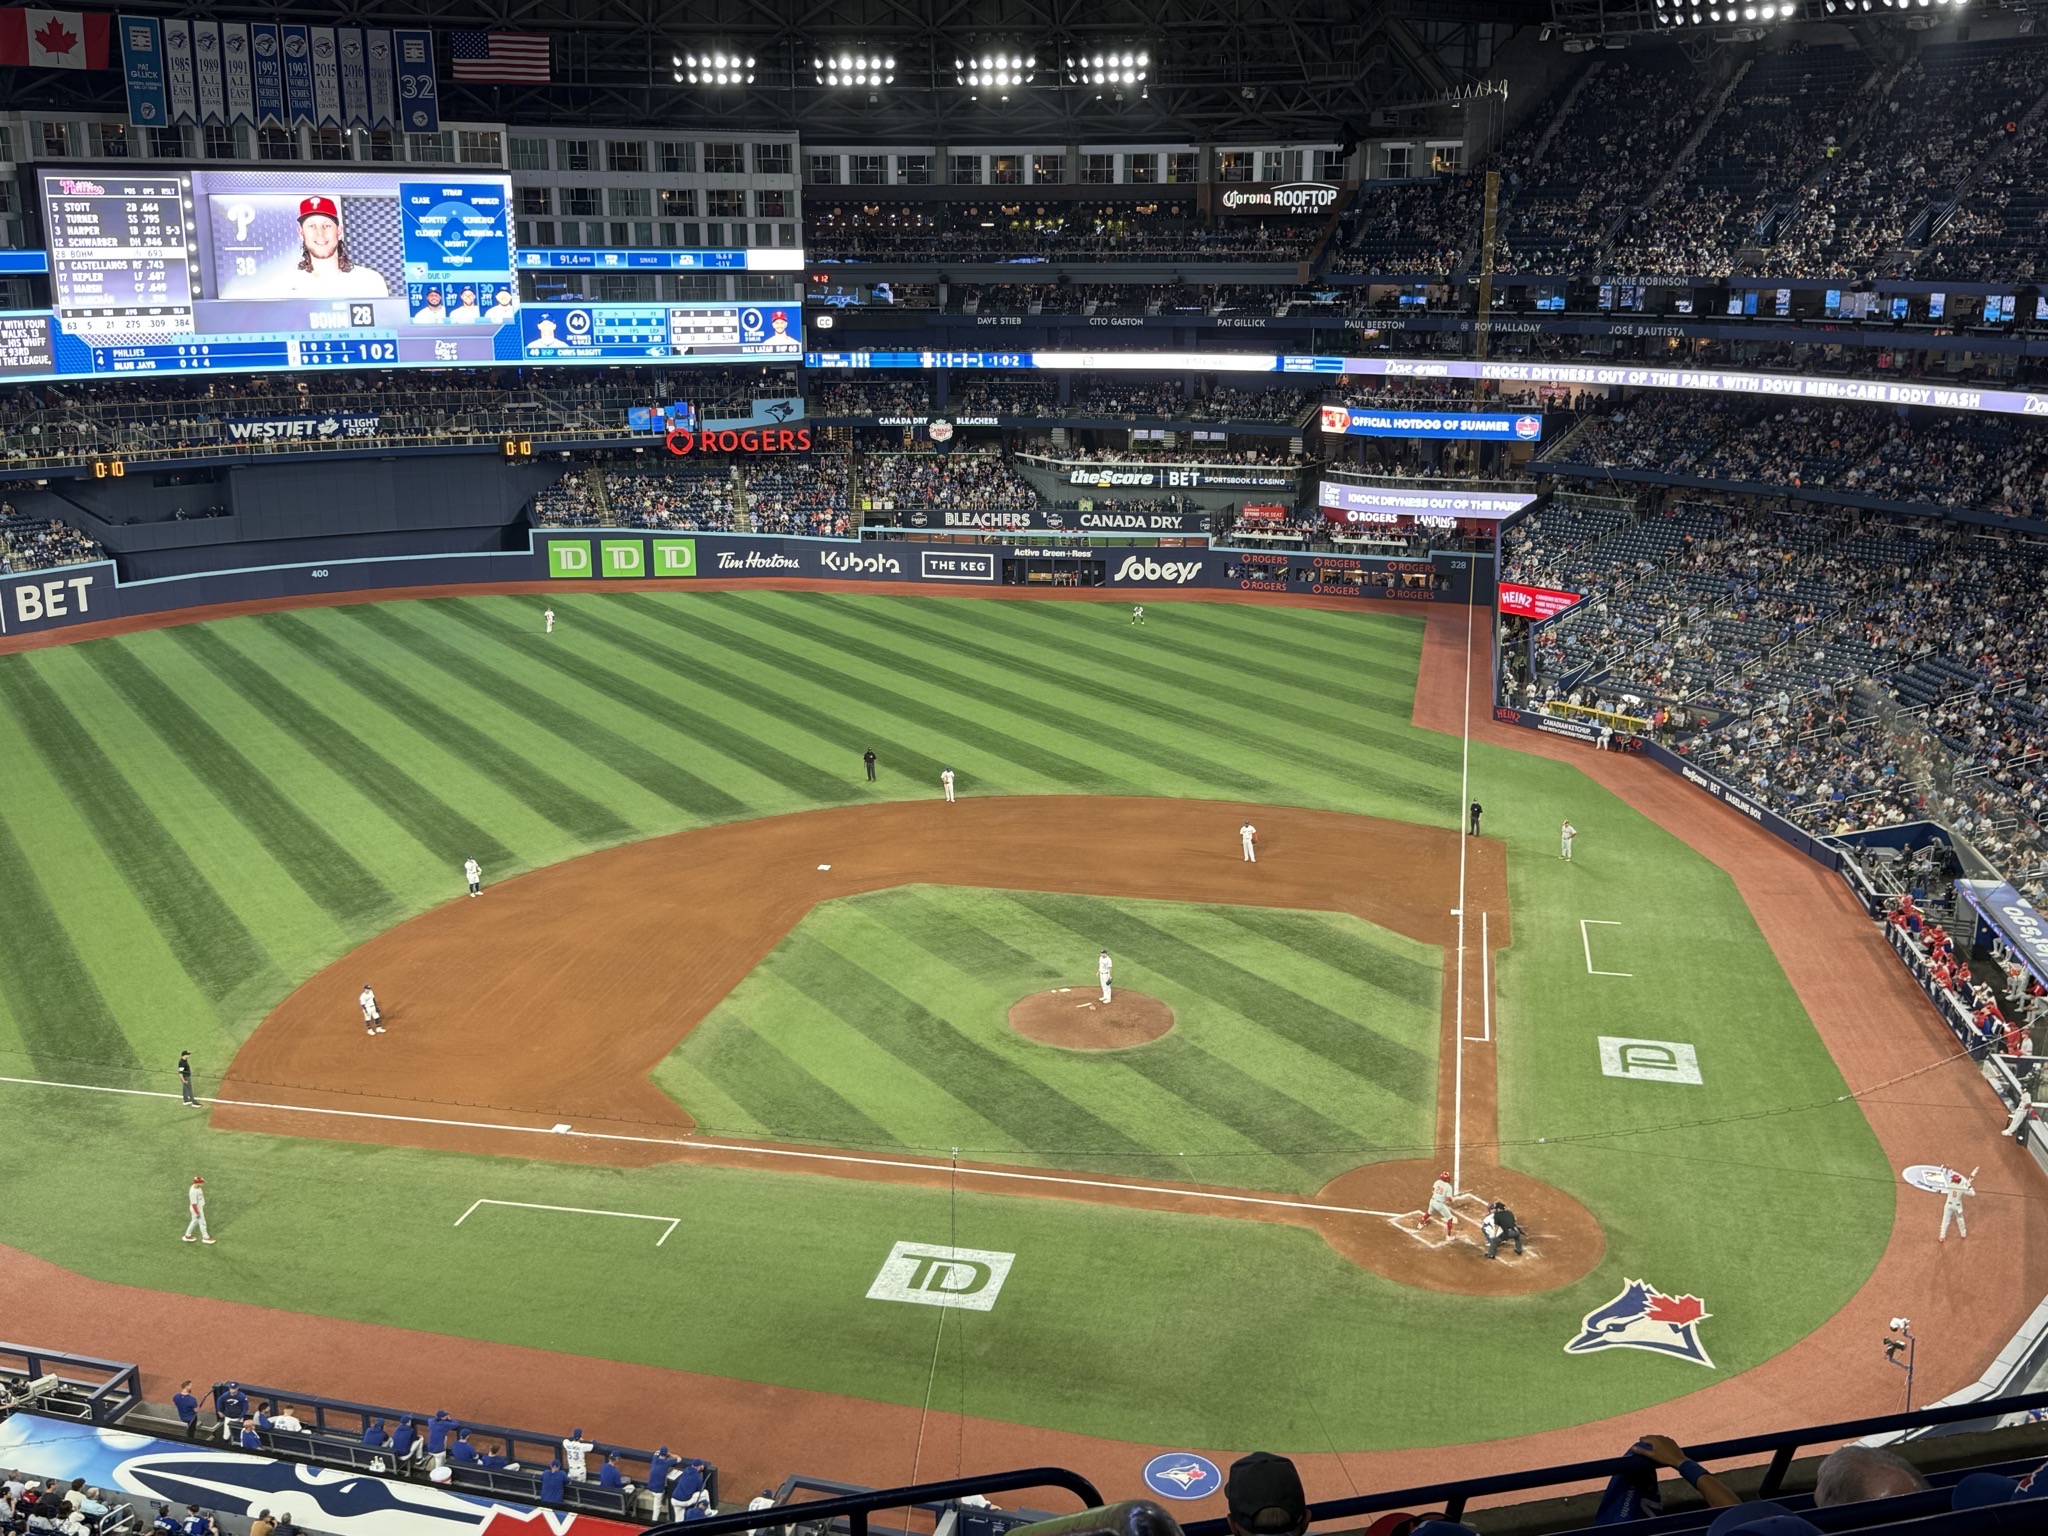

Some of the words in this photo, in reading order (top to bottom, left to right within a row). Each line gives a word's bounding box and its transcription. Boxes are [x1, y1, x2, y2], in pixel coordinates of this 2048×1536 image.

[137, 63, 149, 71] PAT
[170, 57, 191, 71] 1985
[199, 59, 219, 72] 1989
[228, 60, 248, 74] 1991
[257, 61, 278, 76] 1992
[288, 62, 308, 77] 1993
[316, 63, 336, 78] 2015
[344, 64, 364, 78] 2016
[230, 76, 250, 87] A.L.
[258, 77, 279, 87] WORLD
[289, 78, 309, 88] WORLD
[400, 74, 435, 99] 32
[173, 86, 192, 96] EAST
[201, 87, 220, 98] EAST
[230, 88, 250, 99] EAST
[259, 88, 280, 98] SERIES
[290, 89, 310, 98] SERIES
[1223, 190, 1271, 209] Corona
[1274, 190, 1337, 206] ROOFTOP
[64, 203, 90, 212] STOTT
[126, 203, 138, 212] 2B
[140, 203, 159, 212] .664
[1291, 206, 1319, 214] PATIO
[65, 214, 99, 224] TURNER
[127, 214, 138, 223] SS
[141, 214, 160, 223] .795
[67, 226, 100, 235] HARPER
[129, 226, 139, 235] 1B
[165, 225, 180, 235] 5-3
[54, 238, 64, 247] 12
[68, 238, 119, 247] SCHWARBER
[129, 238, 141, 247] DH
[55, 250, 66, 258] 28
[70, 250, 94, 258] BOHM
[560, 254, 578, 264] 91.4
[71, 261, 128, 270] CASTELLANOS
[132, 261, 143, 269] RF
[146, 261, 165, 269] .743
[235, 256, 257, 276] 3B
[59, 273, 67, 282] 17
[72, 273, 103, 282] KEPLER
[1606, 276, 1637, 285] JACKIE
[1639, 276, 1689, 286] ROBINSON
[60, 285, 70, 293] 16
[73, 284, 103, 293] MARSH
[410, 284, 423, 294] 27
[481, 284, 494, 293] 30
[309, 310, 350, 330] BOHM
[352, 305, 373, 326] 28
[571, 316, 585, 326] 44
[977, 317, 997, 325] DAVE
[1000, 317, 1021, 325] STIEB
[4, 320, 24, 330] WITH
[25, 319, 46, 329] FOUR
[67, 321, 78, 330] 63
[106, 321, 115, 329] 21
[1089, 317, 1108, 326] CITO
[1111, 318, 1143, 326] GASTON
[1217, 319, 1232, 327] PAT
[1234, 319, 1265, 327] GILLICK
[1344, 320, 1364, 329] PAUL
[1367, 321, 1405, 329] BEESTON
[1474, 323, 1493, 331] ROY
[1495, 323, 1541, 333] HALLADAY
[1608, 324, 1633, 335] JOSÉ
[1637, 326, 1685, 337] BAUTISTA
[23, 338, 46, 348] WHIFF
[9, 347, 29, 358] 93RD
[113, 348, 145, 357] PHILLIES
[20, 355, 52, 366] LEAGUE,
[114, 361, 134, 370] BLUE
[137, 361, 156, 369] JAYS
[1385, 360, 1412, 374] Dove
[1481, 365, 1528, 379] KNOCK
[1531, 366, 1595, 382] DRYNESS
[1597, 369, 1625, 383] OUT
[1628, 371, 1647, 384] OF
[1651, 372, 1677, 386] THE
[1681, 374, 1720, 388] PARK
[1722, 376, 1759, 391] WITH
[1762, 378, 1802, 394] DOVE
[1805, 381, 1887, 400] MEN+CARE
[1889, 387, 1931, 404] BODY
[1934, 390, 1980, 408] WASH
[879, 417, 911, 425] CANADA
[912, 417, 928, 425] DRY
[956, 417, 998, 425] BLEACHERS
[1352, 416, 1392, 428] OFFICIAL
[1393, 419, 1441, 430] HOTDOG
[1443, 420, 1458, 431] OF
[1460, 420, 1509, 432] SUMMER
[229, 420, 317, 438] WESTJET
[342, 417, 380, 428] FLIGHT
[349, 426, 376, 437] DECK
[699, 429, 811, 452] ROGERS
[506, 440, 531, 456] 0:10
[95, 461, 124, 478] 0:10
[1070, 470, 1154, 486] theScore
[1169, 472, 1200, 487] BET
[1204, 477, 1251, 485] SPORTSBOOK
[1259, 478, 1285, 486] CASINO
[1347, 493, 1381, 506] KNOCK
[1381, 495, 1429, 508] DRYNESS
[1429, 497, 1451, 509] OUT
[1452, 498, 1469, 510] OF
[1470, 499, 1492, 511] THE
[1492, 500, 1523, 512] PARK
[945, 512, 1030, 527] BLEACHERS
[1080, 514, 1148, 528] CANADA
[1150, 515, 1183, 529] DRY
[1359, 512, 1397, 523] ROGERS
[553, 547, 588, 570] TD
[605, 547, 640, 570] TD
[657, 546, 692, 569] TD
[1014, 548, 1040, 557] Active
[1042, 549, 1092, 558] Green+Ross
[716, 552, 744, 569] Tim
[744, 551, 800, 569] Hortons
[820, 551, 901, 574] Kubota
[1252, 555, 1288, 565] ROGERS
[1324, 560, 1360, 568] ROGERS
[1451, 561, 1467, 569] 328
[930, 560, 955, 571] THE
[961, 560, 986, 572] KEG
[1114, 555, 1203, 584] Sobeys
[1398, 562, 1436, 572] ROGERS
[311, 569, 329, 578] 400
[1251, 581, 1287, 591] ROGERS
[1323, 587, 1359, 595] ROGERS
[15, 576, 93, 622] BET
[1397, 590, 1435, 599] ROGERS
[1502, 591, 1533, 608] HEINZ
[1496, 709, 1521, 722] HEINZ
[1543, 718, 1569, 731] CANADIAN
[1537, 724, 1548, 732] MADE
[1557, 728, 1576, 738] CANADIAN
[1682, 766, 1708, 788] theScore
[1709, 781, 1721, 796] BET
[1725, 792, 1750, 814] BASELINE
[1749, 806, 1762, 821] BOX
[1618, 1044, 1679, 1074] TD
[901, 1253, 992, 1295] TD
